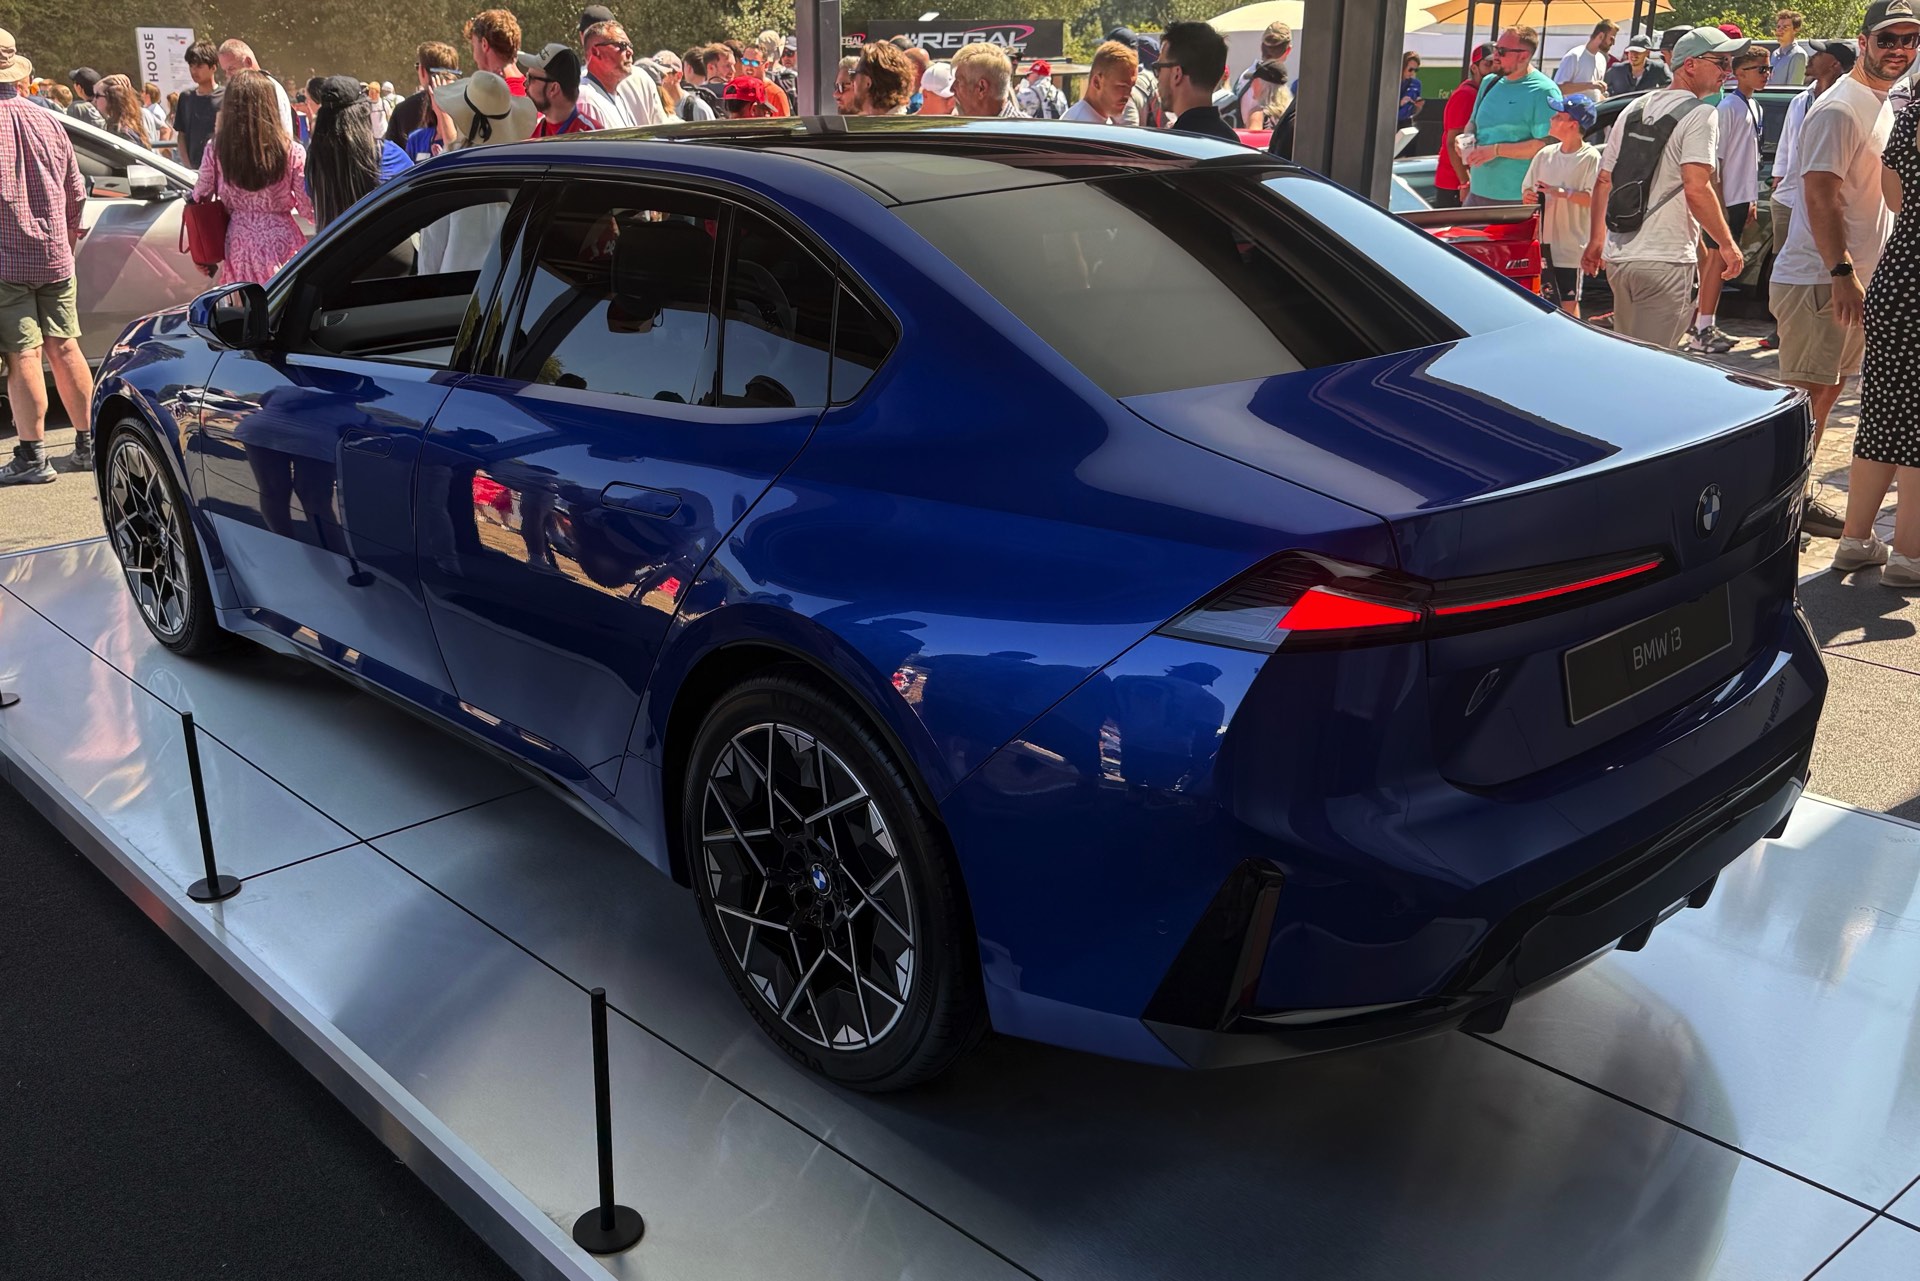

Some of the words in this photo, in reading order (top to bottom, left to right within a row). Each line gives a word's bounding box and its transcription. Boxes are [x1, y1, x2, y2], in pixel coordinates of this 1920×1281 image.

[143, 33, 159, 82] HOUSE
[917, 31, 1028, 49] REGAL
[1632, 632, 1668, 671] BMW
[1670, 626, 1682, 653] i3
